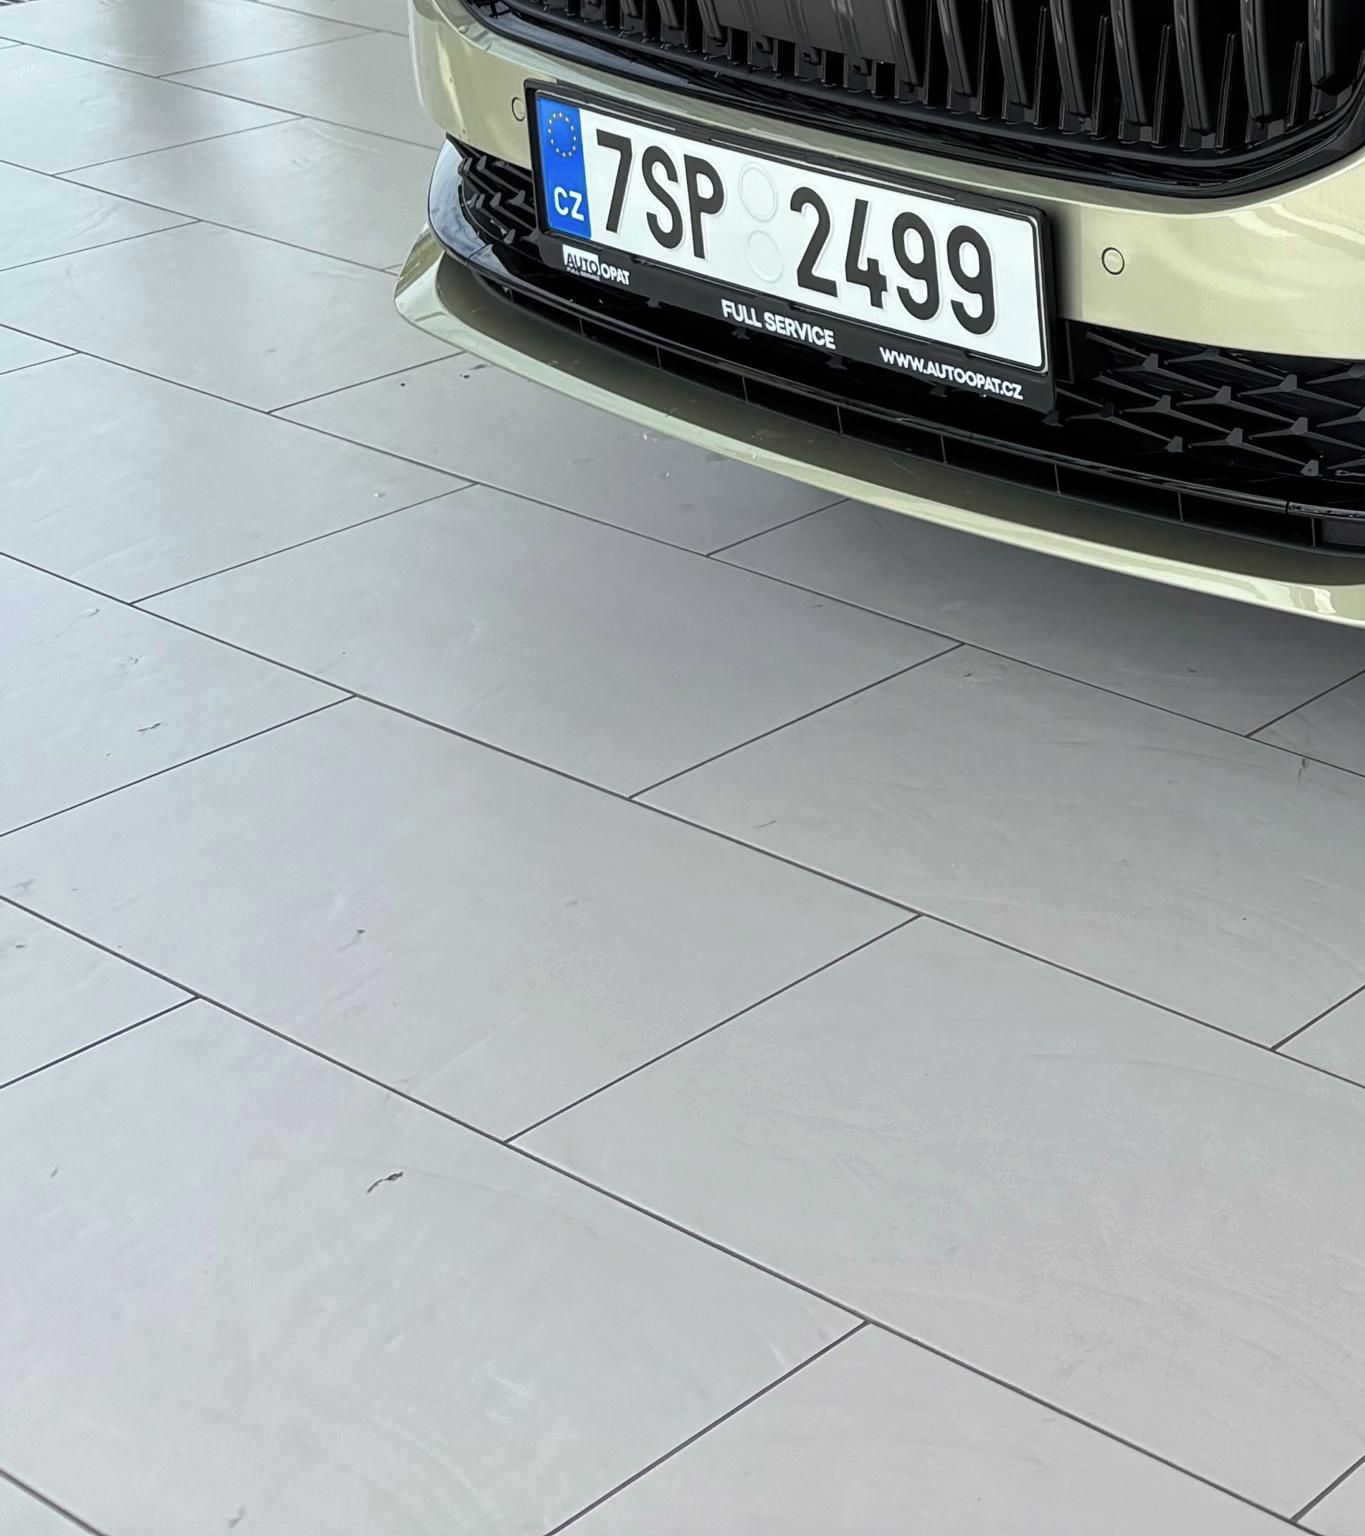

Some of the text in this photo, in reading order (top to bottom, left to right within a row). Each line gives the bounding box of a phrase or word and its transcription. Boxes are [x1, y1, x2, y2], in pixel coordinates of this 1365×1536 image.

[554, 186, 585, 222] CZ
[595, 128, 996, 336] 7SP 2499
[720, 298, 837, 351] FULL SERVICE
[879, 346, 1024, 401] WWW.AUTOOPAT.CZ
